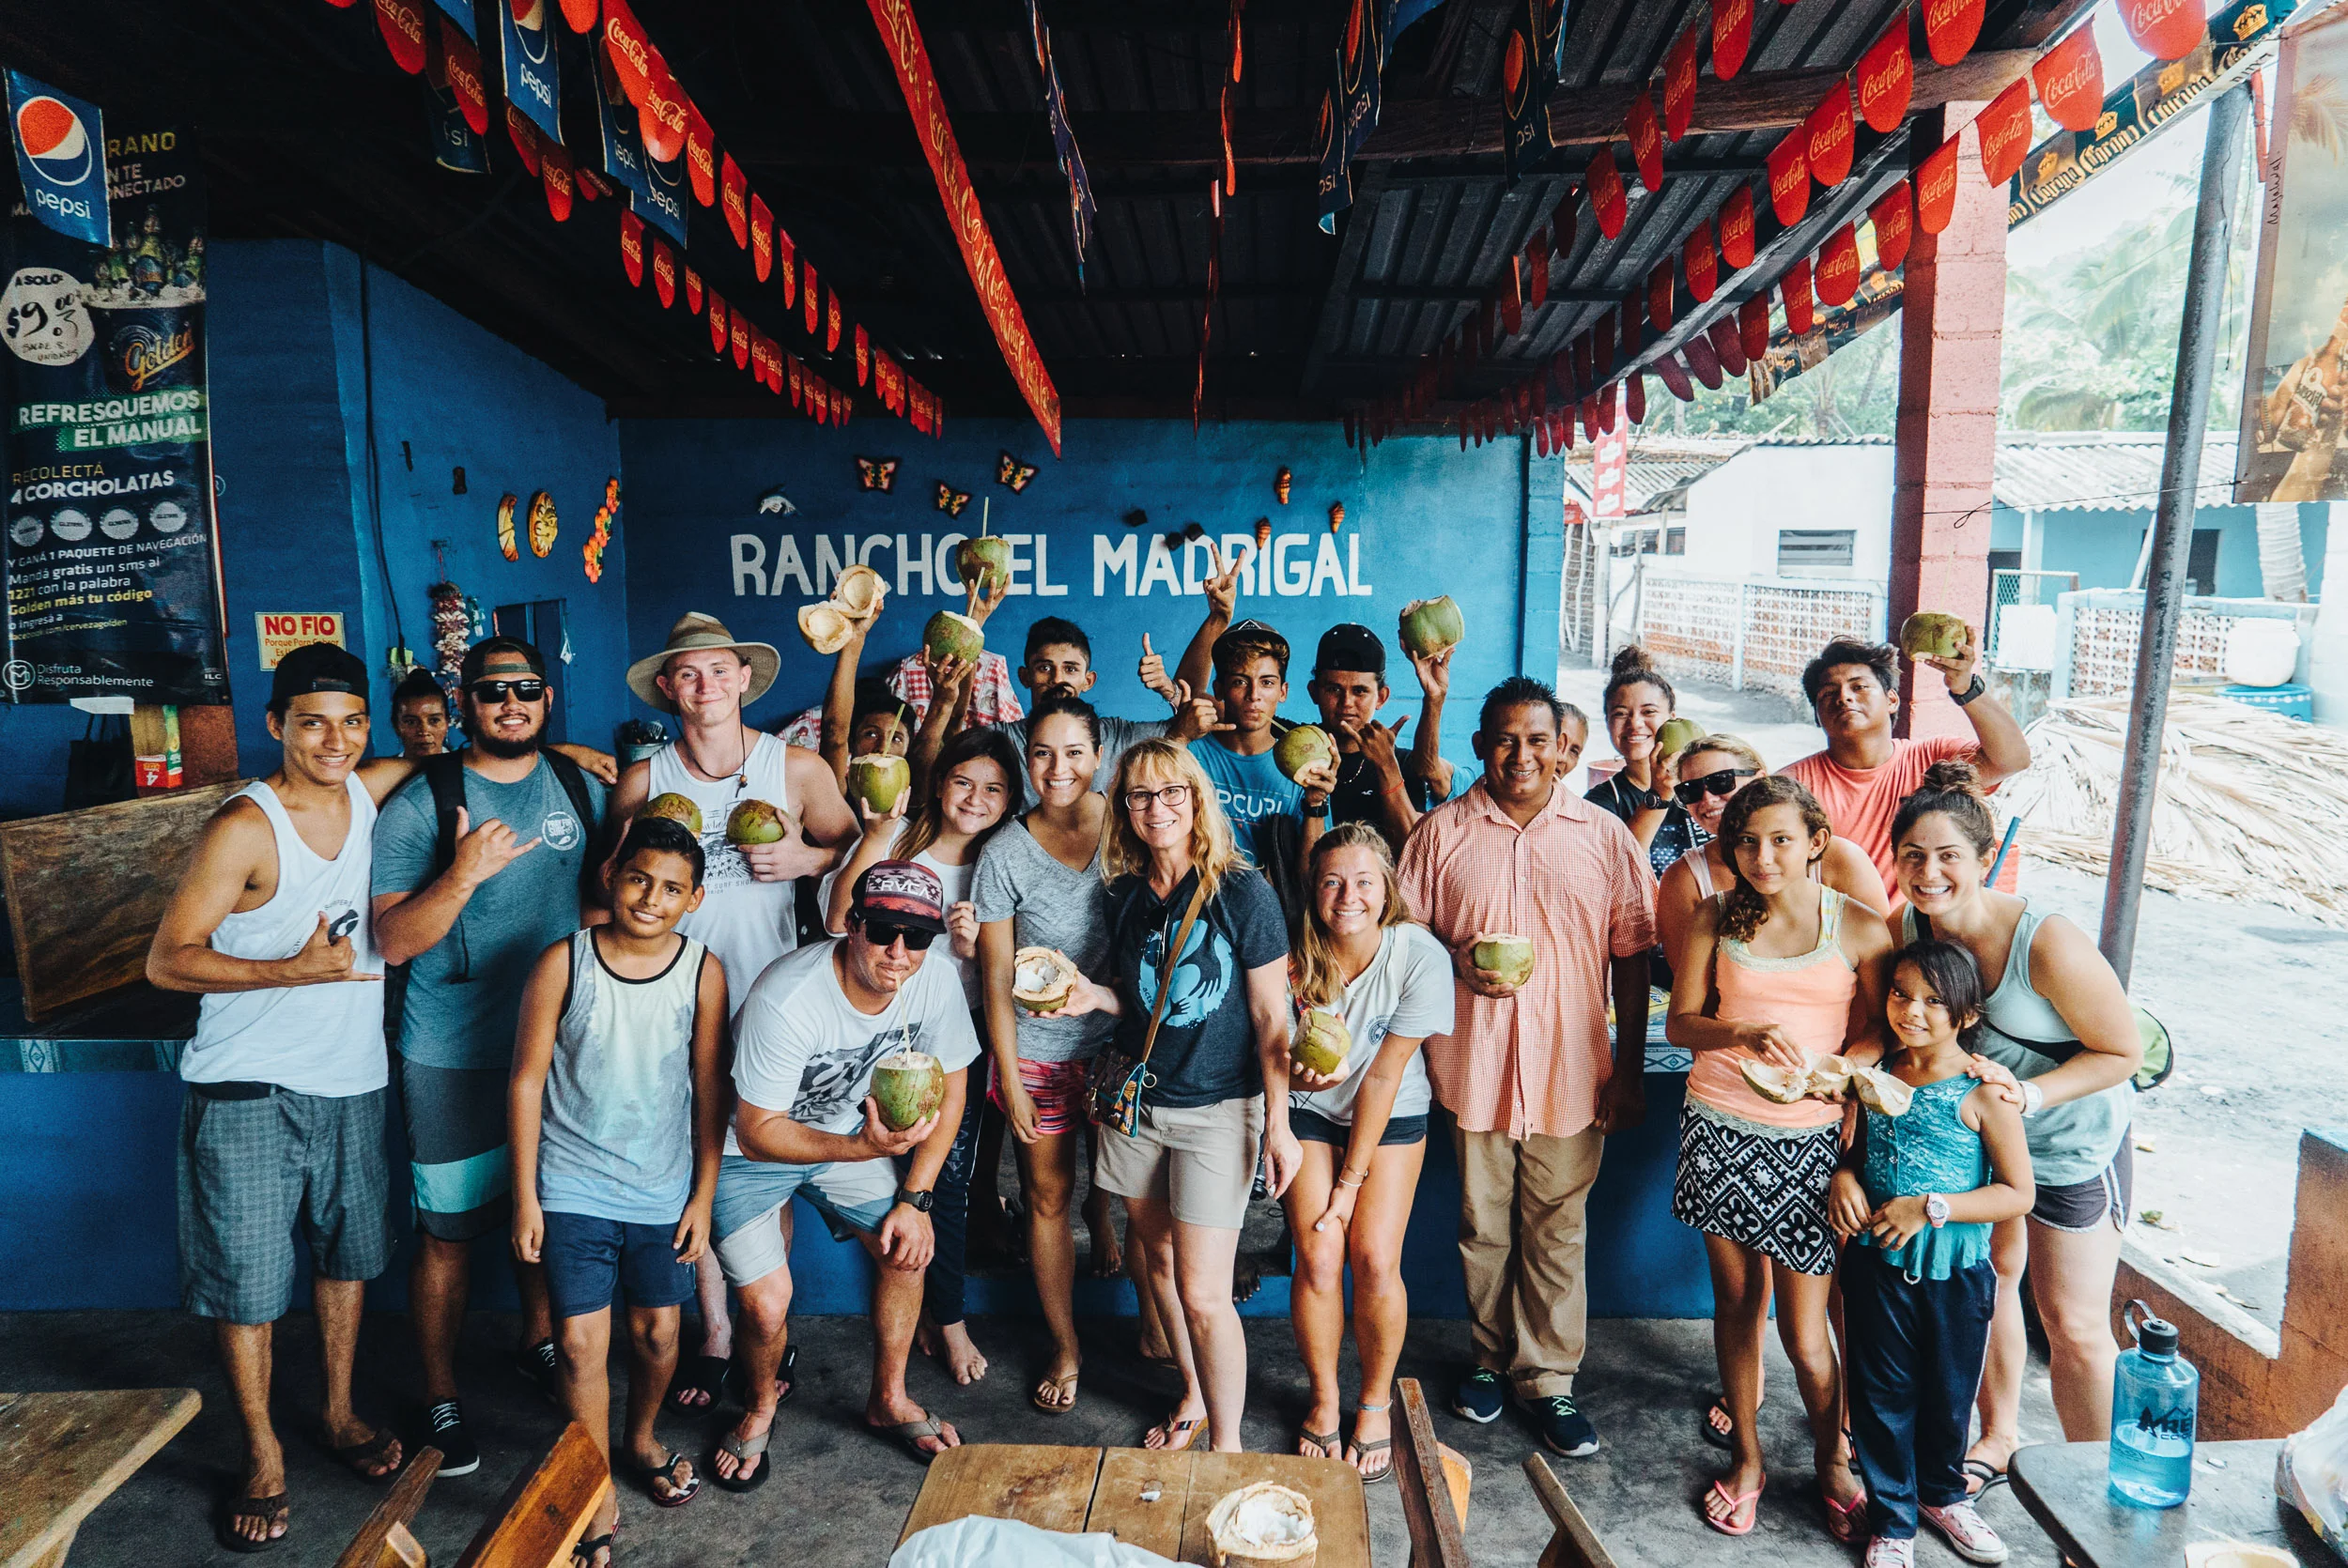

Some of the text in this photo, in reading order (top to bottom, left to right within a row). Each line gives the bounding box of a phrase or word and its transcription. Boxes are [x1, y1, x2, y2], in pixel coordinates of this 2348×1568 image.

[520, 63, 552, 108] pepsi
[123, 163, 142, 178] TE
[36, 189, 91, 219] pepsi
[19, 390, 200, 425] REFRESQUEMOS
[74, 416, 202, 448] EL MANUAL
[10, 469, 176, 504] 4 CORCHOLATAS
[8, 559, 16, 568] Y
[50, 551, 55, 561] 1
[58, 546, 115, 560] PAQUETE
[118, 545, 133, 555] DE
[136, 533, 207, 552] NAVEGACIÓN
[53, 564, 93, 580] gratis
[97, 564, 115, 574] un
[118, 561, 146, 572] sms
[148, 556, 160, 568] al
[1009, 534, 1068, 596] EL
[1093, 532, 1373, 597] MADRIGAL
[39, 584, 59, 595] con
[63, 580, 75, 592] la
[79, 576, 131, 592] palabra
[8, 589, 152, 616] Golden más tu código
[264, 616, 335, 636] NO FIO
[265, 638, 292, 647] Porque
[276, 649, 284, 657] Es
[38, 664, 82, 674] Disfruta
[38, 675, 154, 687] Responsablemente
[881, 879, 930, 899] RVCA
